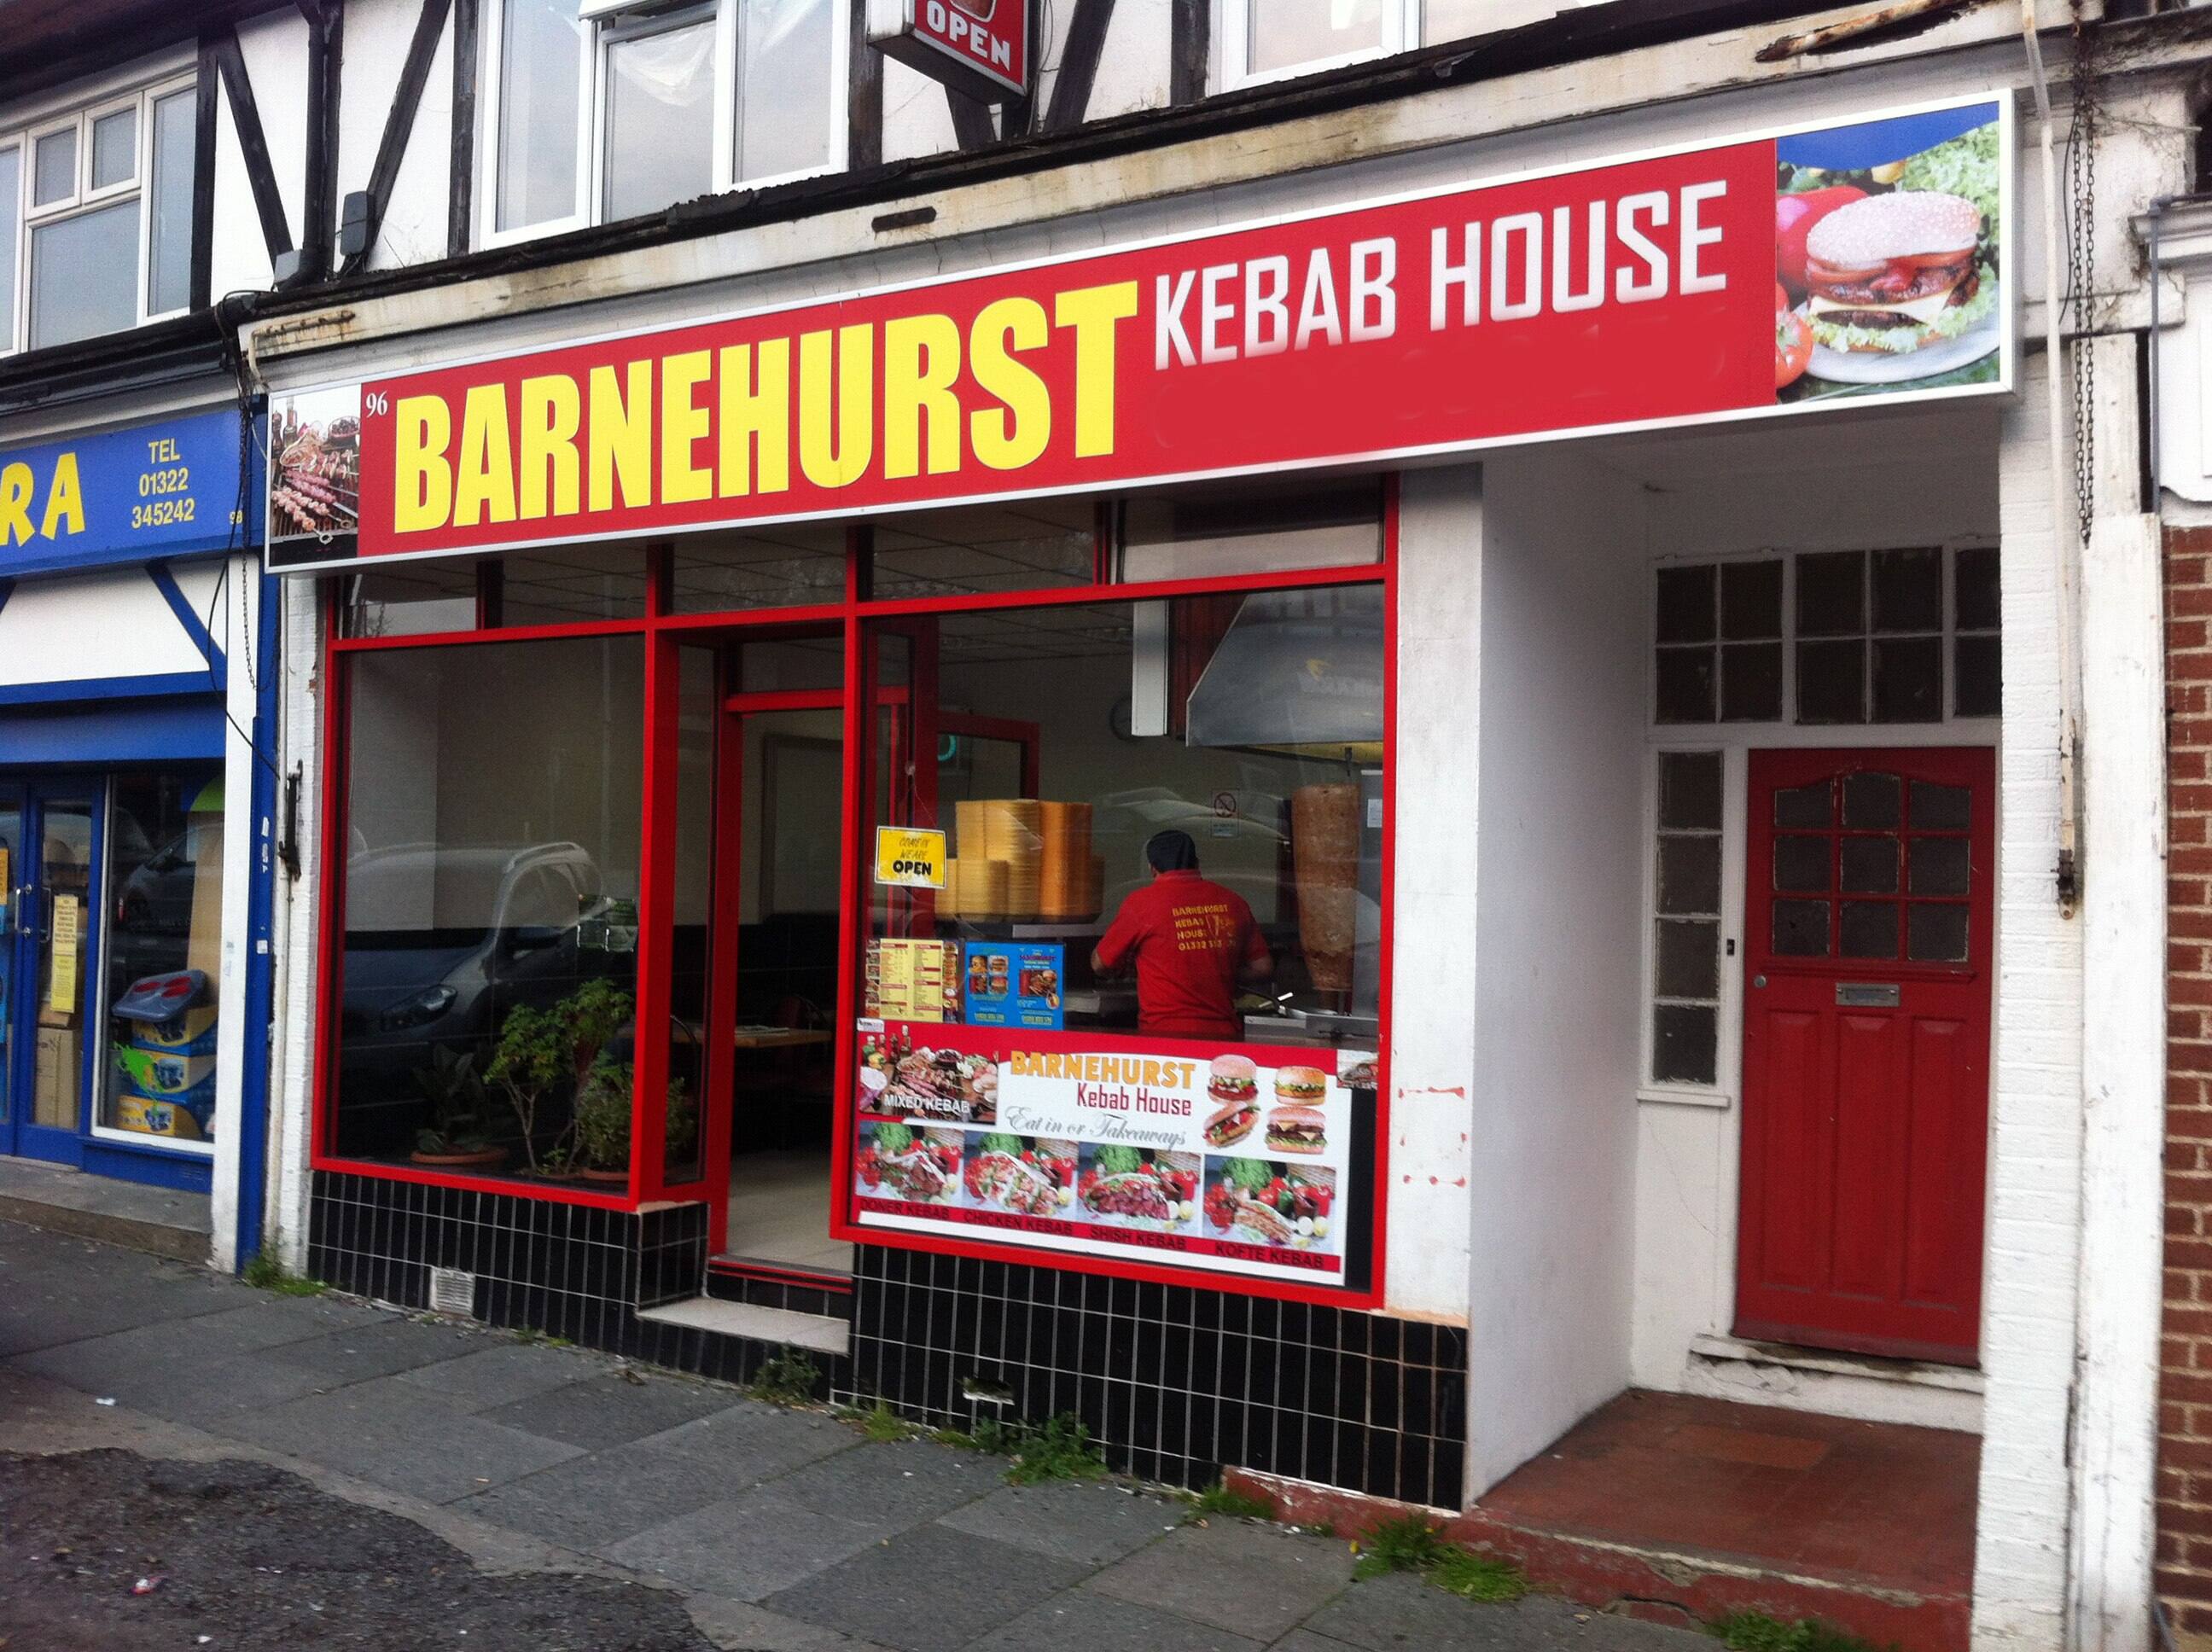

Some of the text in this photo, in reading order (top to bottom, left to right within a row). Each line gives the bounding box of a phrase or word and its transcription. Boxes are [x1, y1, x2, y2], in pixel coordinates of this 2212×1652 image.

[926, 0, 1010, 72] OPEN
[393, 180, 1727, 534] BARNEHURST KEBAB HOUSE
[365, 391, 388, 418] 96
[148, 438, 181, 464] TEL
[139, 468, 189, 497] 01322
[131, 498, 195, 529] 345242
[893, 860, 932, 875] OPEN
[1010, 1050, 1196, 1090] BARNEHURST
[883, 1094, 971, 1113] MIXED KEBAB
[1077, 1082, 1192, 1116] Kebab House
[1004, 1106, 1187, 1149] Eat in or Takeaways
[859, 1198, 950, 1219] DONER KEBAB
[963, 1210, 1073, 1236] CHICKEN KEBAB
[1091, 1226, 1186, 1250] SHISH KEBAB
[1215, 1242, 1323, 1268] KOFTE KEBAB
